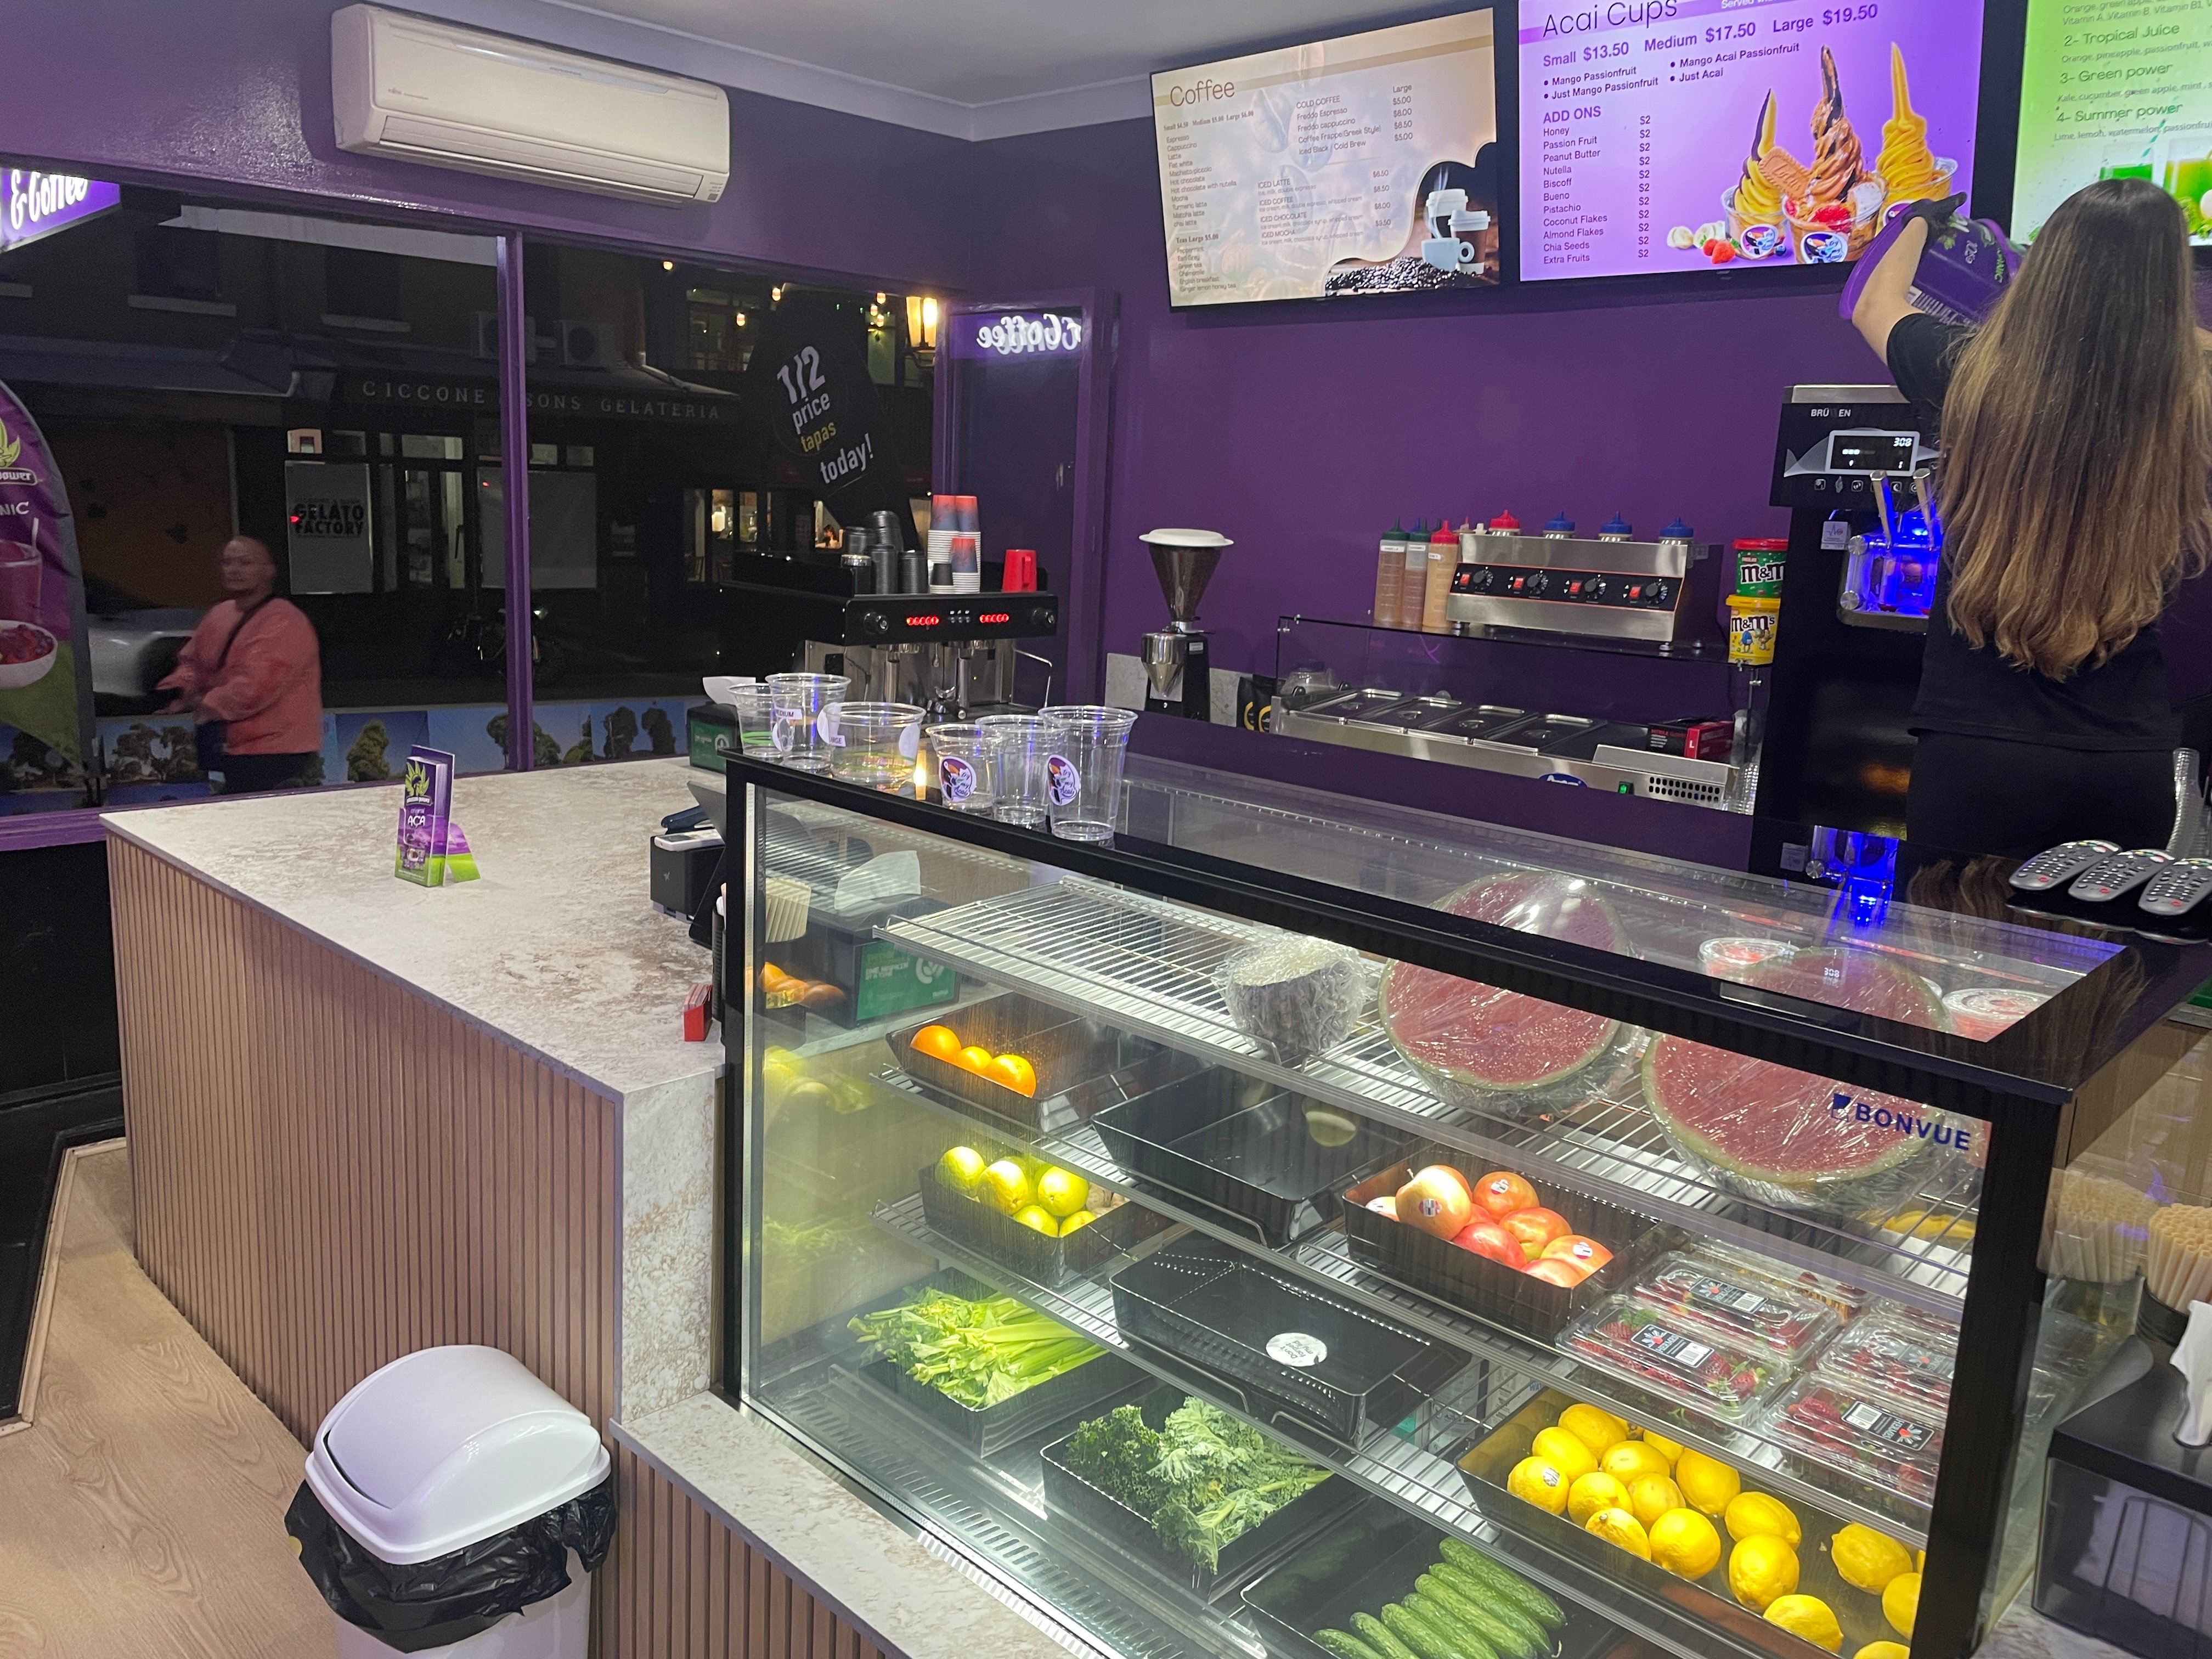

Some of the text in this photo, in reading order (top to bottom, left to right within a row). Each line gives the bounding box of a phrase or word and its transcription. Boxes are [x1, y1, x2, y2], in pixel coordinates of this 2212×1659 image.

[1543, 0, 1677, 38] Acai Cups
[1543, 4, 1878, 66] Small $13.50 Medium $17.50 Large $19.50
[2083, 26, 2138, 44] Tropical
[2142, 24, 2180, 37] Juice
[1679, 42, 1800, 68] Mango Acai Passionfruit
[1552, 66, 1637, 86] Mango Passionfruit
[1679, 67, 1723, 82] Just Acai
[2079, 70, 2122, 82] Green
[2126, 64, 2173, 80] power
[1170, 79, 1235, 106] Coffee
[1393, 84, 1412, 93] Large
[1552, 77, 1658, 99] Just Mango Passionfruit
[1296, 95, 1340, 109] COLD COFFEE
[1297, 112, 1318, 120] Freddo
[1543, 105, 1601, 124] ADD ONS
[2075, 109, 2133, 122] Summer
[2136, 104, 2183, 119] power
[1297, 123, 1319, 132] Freddo
[1543, 127, 1570, 137] Honey
[1298, 134, 1319, 144] Coffee
[1543, 136, 1597, 149] Passion Fruit
[1299, 140, 1366, 155] Iced Black Cold Brew
[1543, 149, 1601, 162] Peanut Butter
[1543, 165, 1572, 176] Nutella
[1543, 178, 1572, 188] Biscoff
[1543, 193, 1570, 201] Bueno
[1543, 203, 1581, 214] Pistachio
[1543, 214, 1607, 227] Coconut Flakes
[1543, 228, 1604, 239] Almond Flakes
[1543, 241, 1590, 252] Chia Seeds
[1543, 254, 1590, 264] Extra Fruits
[777, 346, 826, 405] 1/2
[362, 380, 486, 405] CICCONE
[601, 397, 720, 421] GELATERIA
[792, 391, 831, 435] price
[801, 420, 837, 453] tapas
[820, 433, 873, 485] today!
[294, 500, 364, 521] GELATO
[295, 521, 364, 534] FACTORY
[1689, 740, 1695, 748] L
[1855, 1102, 1971, 1150] BONVUE
